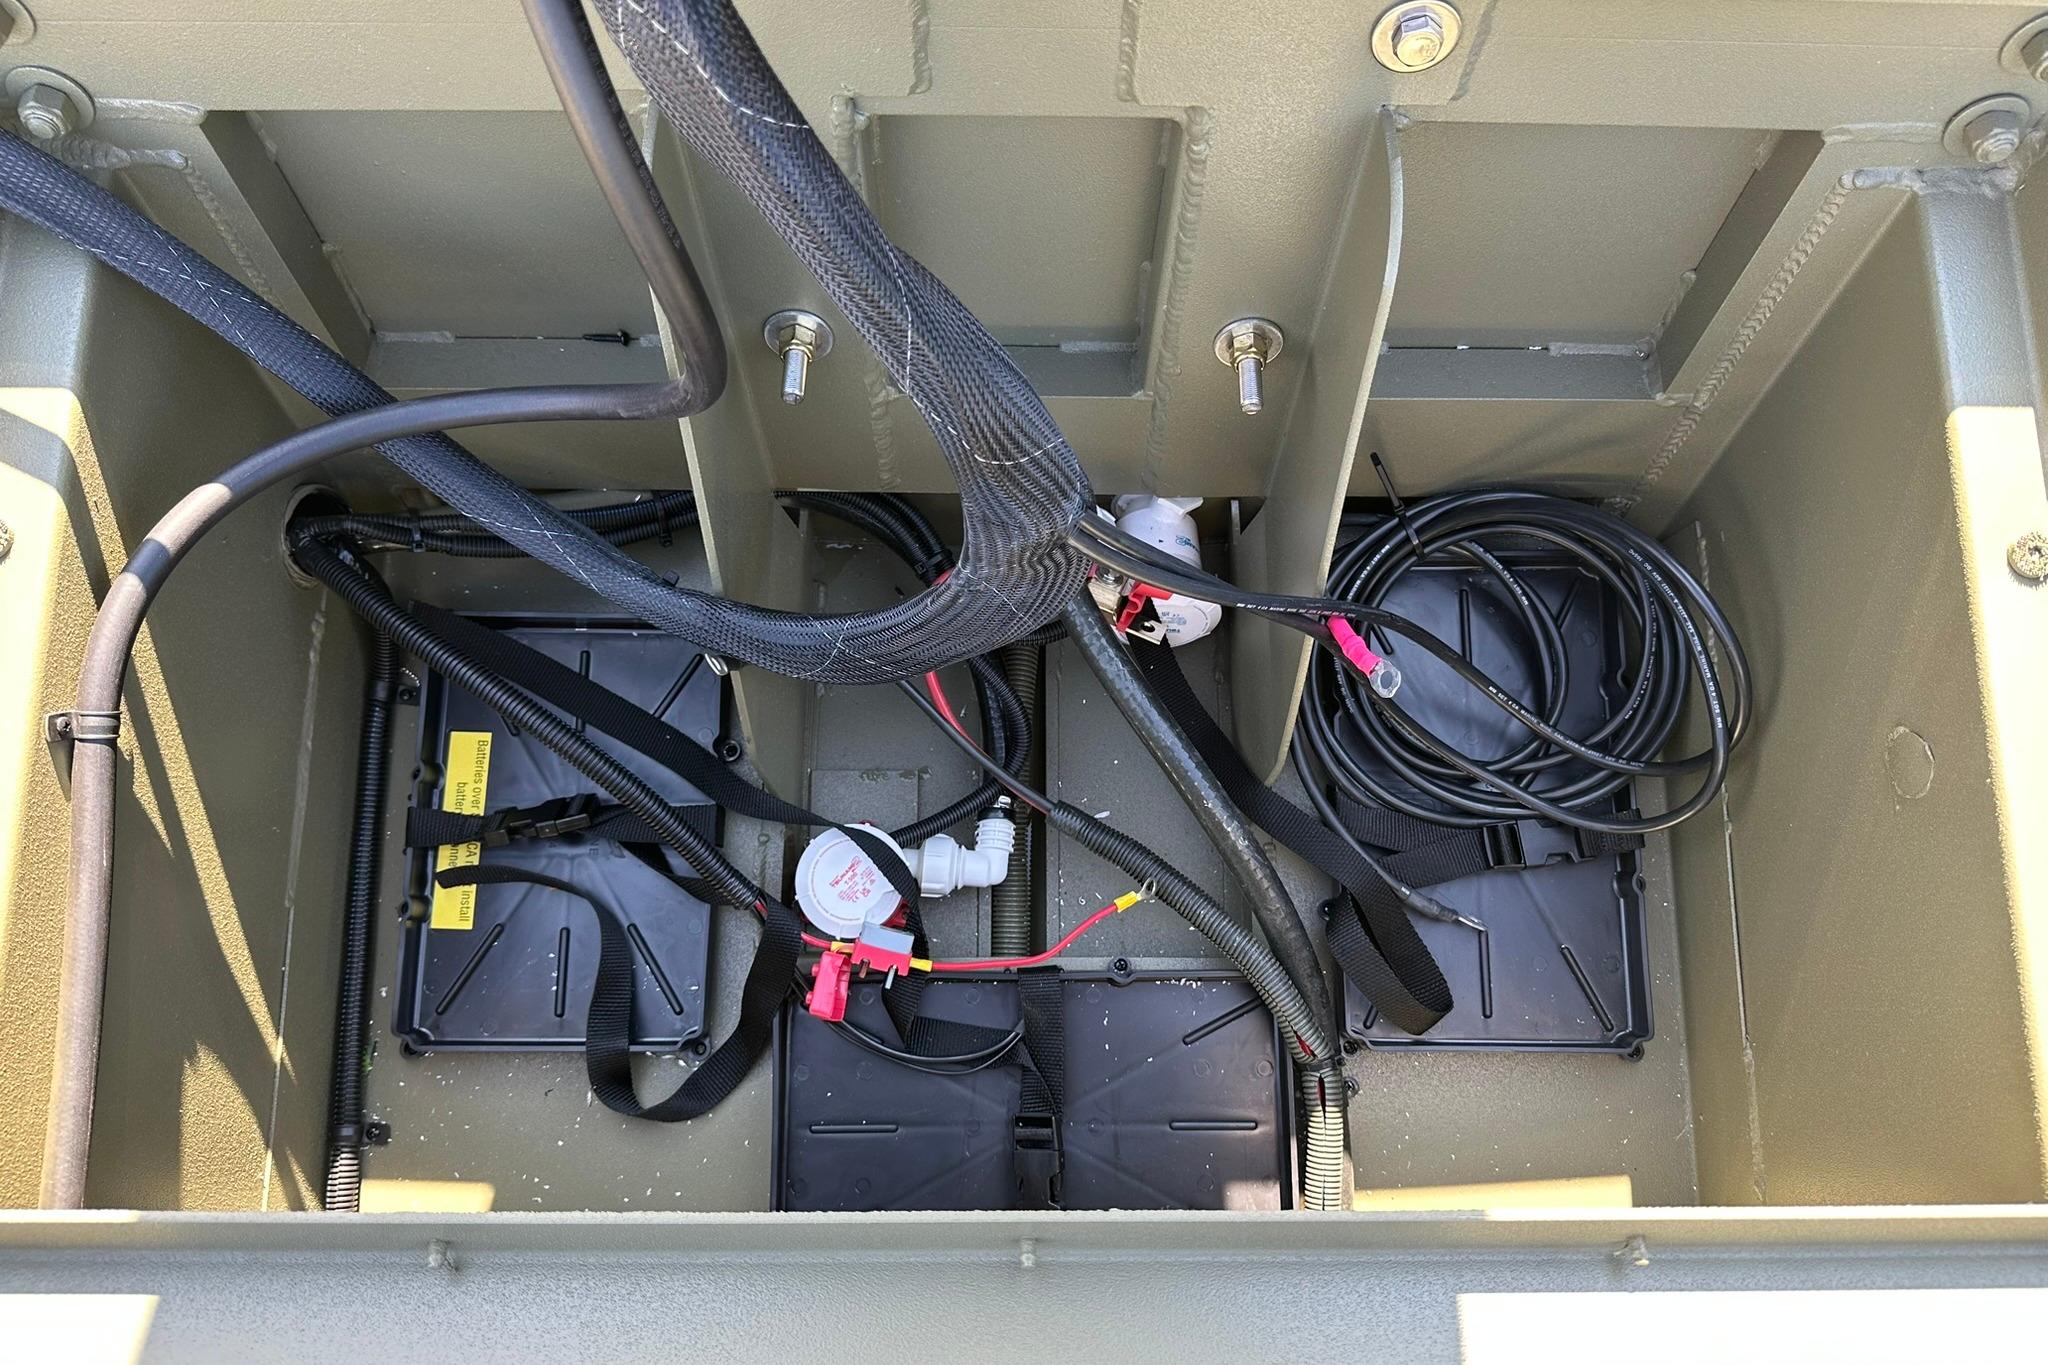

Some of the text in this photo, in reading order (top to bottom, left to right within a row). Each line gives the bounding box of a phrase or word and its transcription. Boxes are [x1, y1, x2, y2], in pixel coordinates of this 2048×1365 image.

[1700, 655, 1711, 678] MARINE
[1712, 699, 1720, 712] SGT
[1715, 717, 1722, 728] MM
[473, 740, 489, 784] Batteries
[454, 781, 469, 811] batter
[471, 787, 482, 810] over
[466, 842, 478, 858] CA
[459, 890, 473, 922] install
